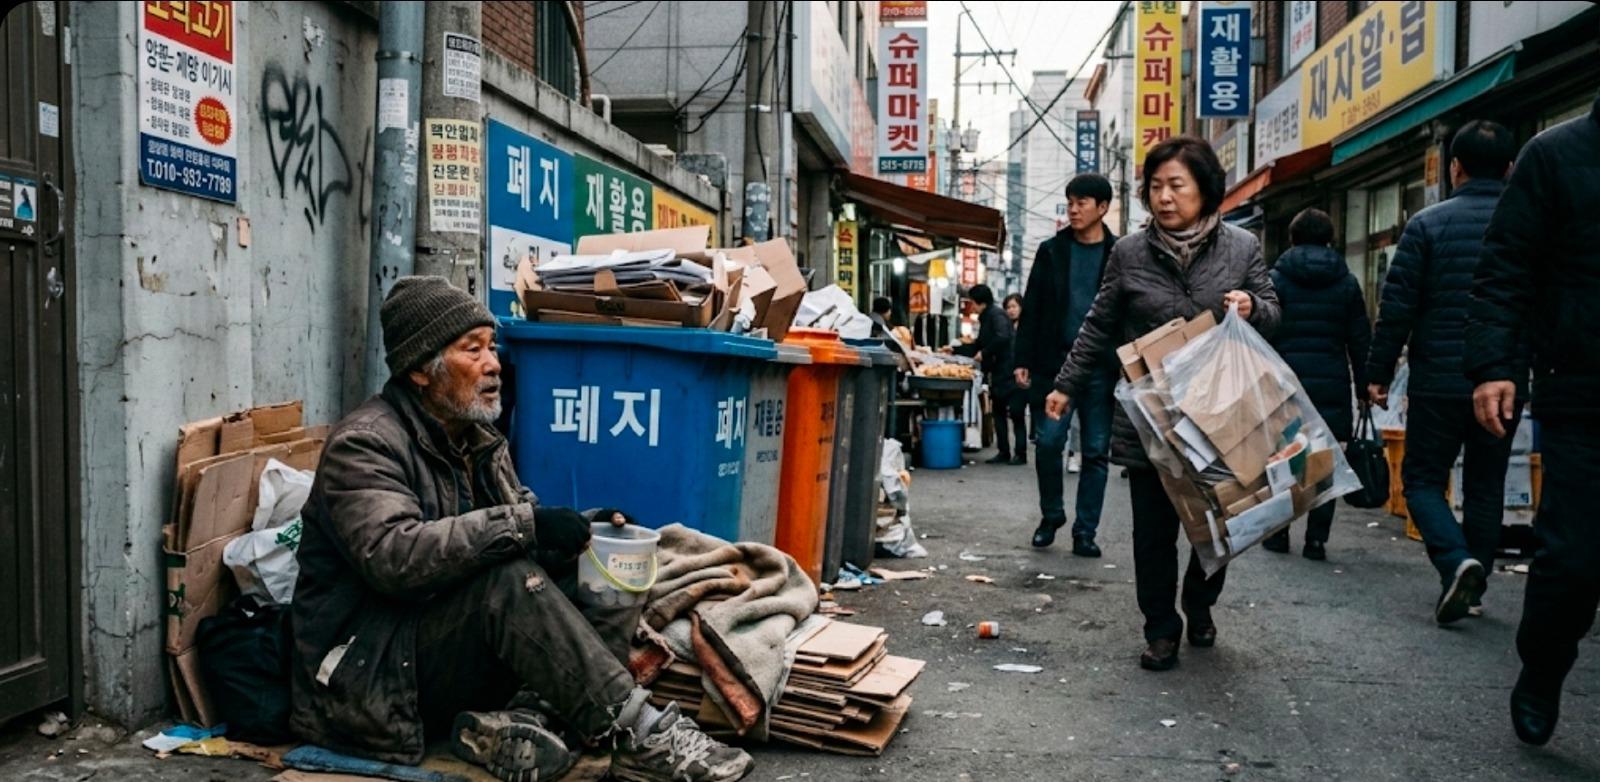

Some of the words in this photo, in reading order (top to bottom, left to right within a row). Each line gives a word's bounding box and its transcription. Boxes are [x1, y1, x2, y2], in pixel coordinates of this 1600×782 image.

[888, 32, 919, 152] 슈퍼마켓
[1209, 13, 1242, 111] 재활용
[507, 145, 560, 220] 폐지
[550, 385, 661, 447] 폐지
[715, 396, 746, 450] 폐지
